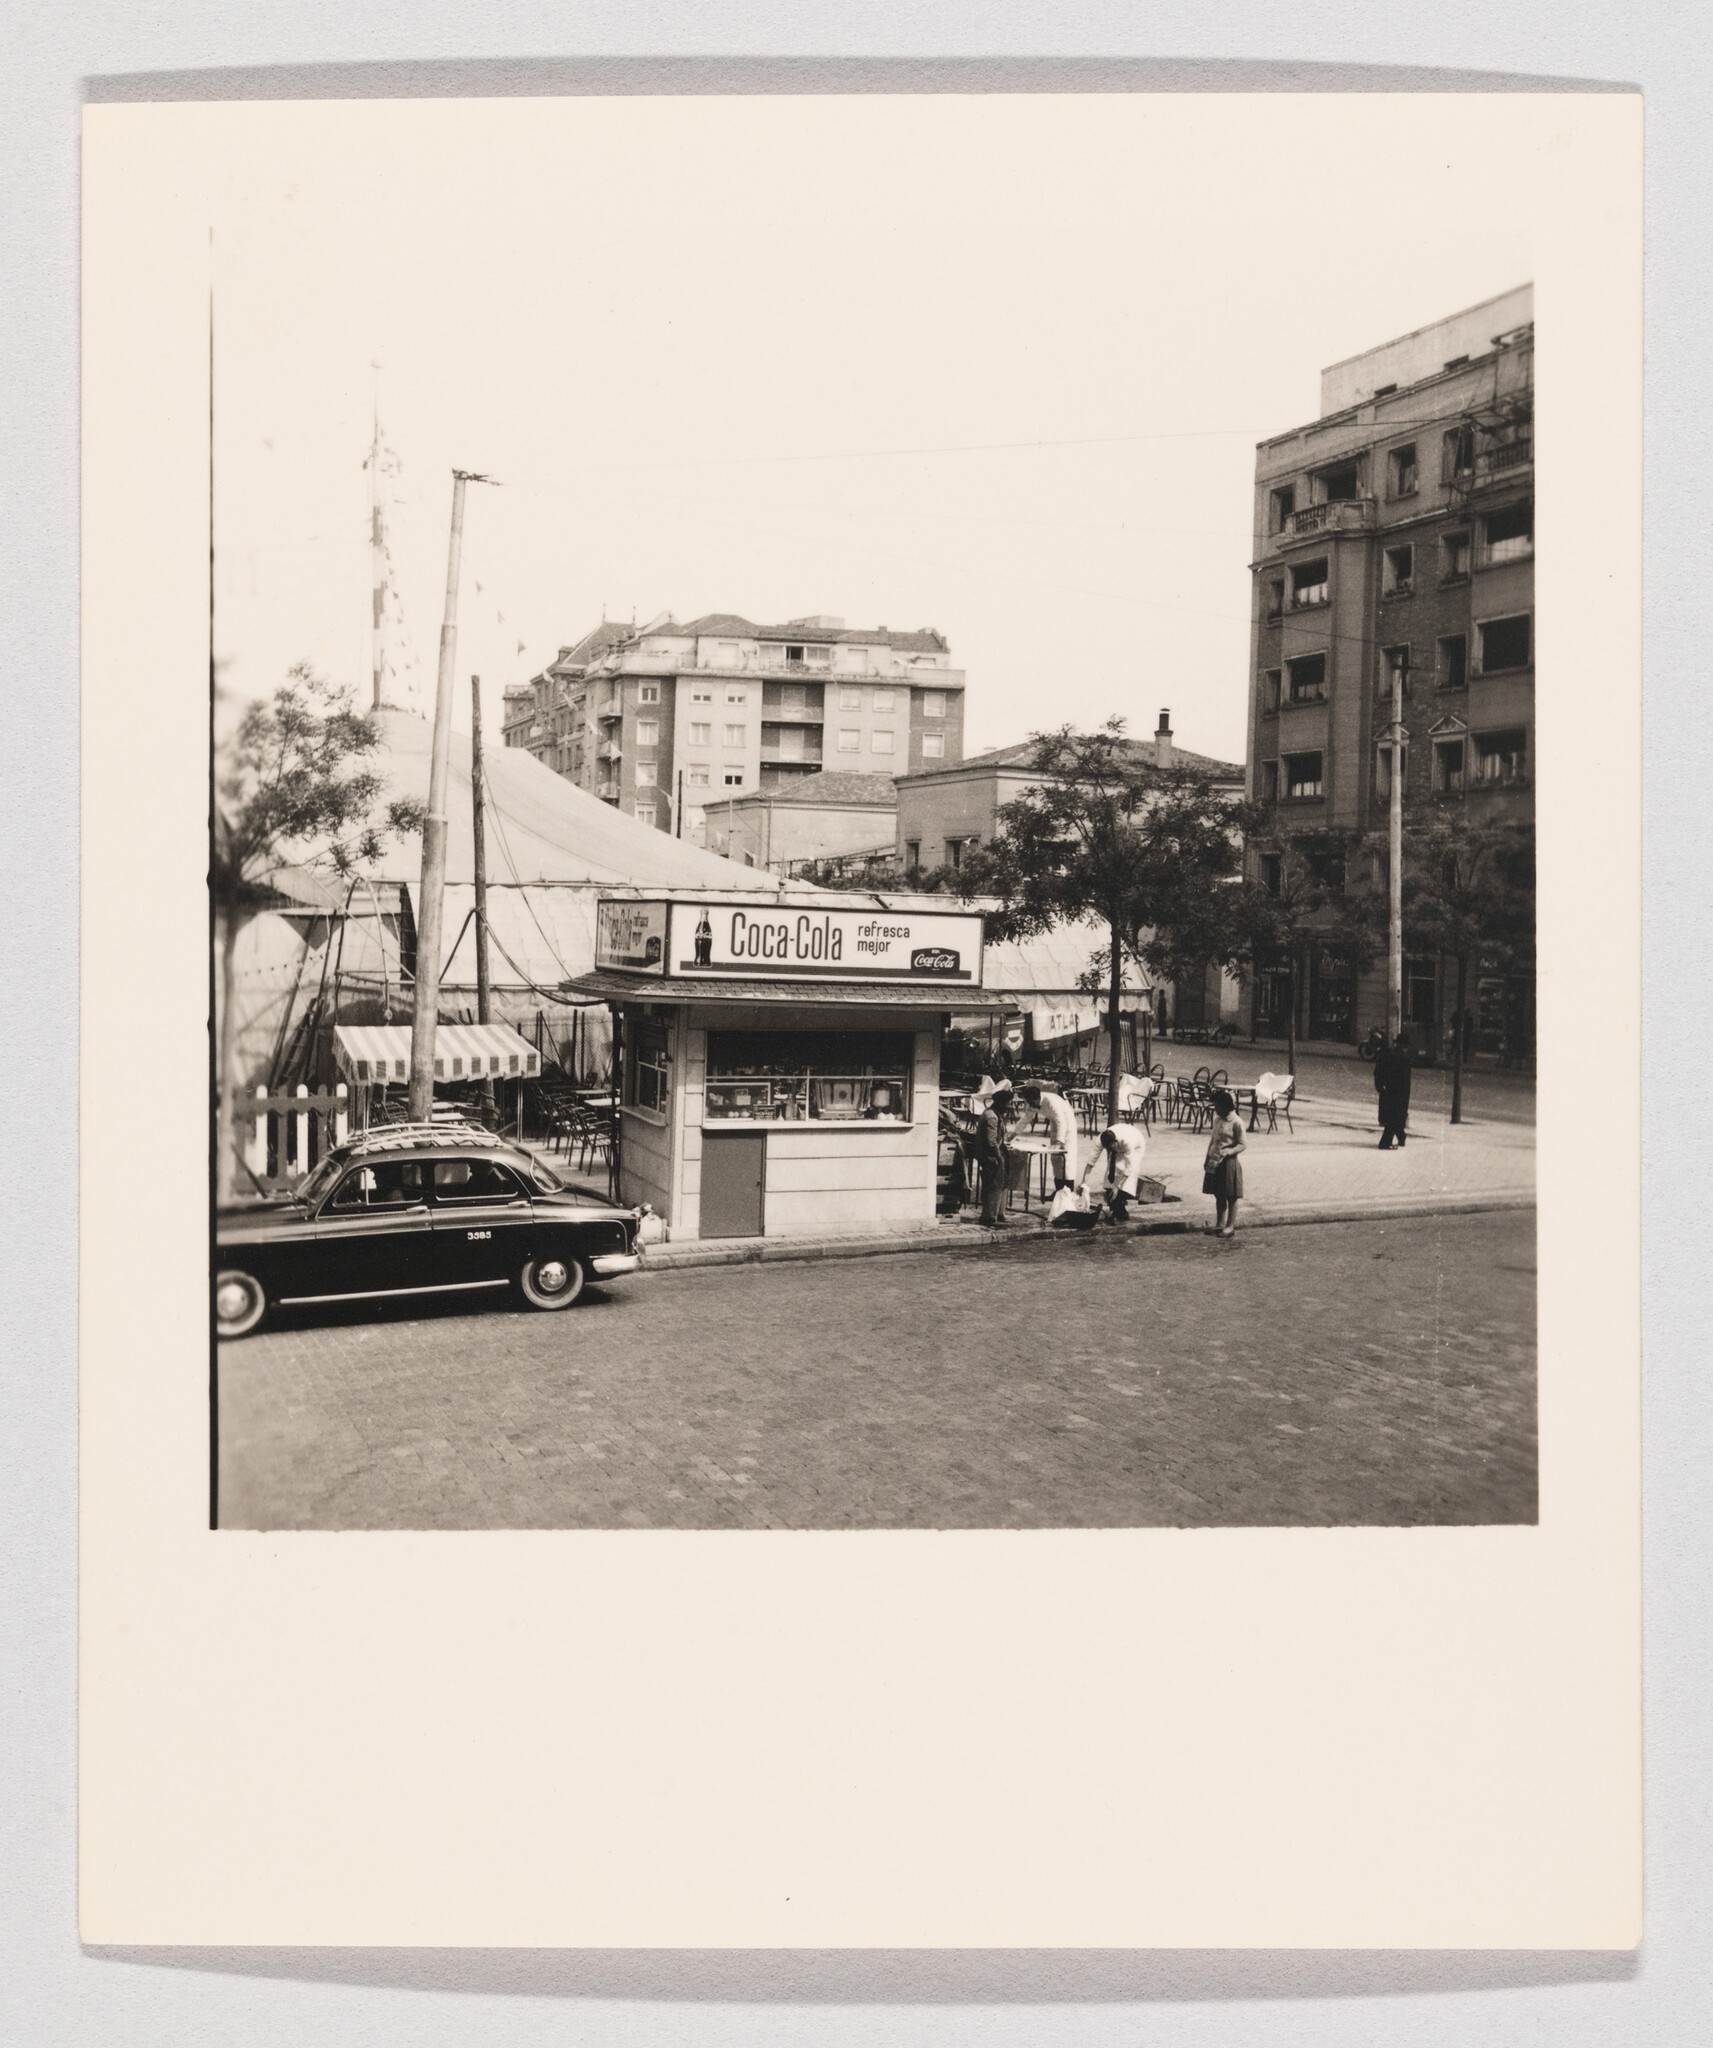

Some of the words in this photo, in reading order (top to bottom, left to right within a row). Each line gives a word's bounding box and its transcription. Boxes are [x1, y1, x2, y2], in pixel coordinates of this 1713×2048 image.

[730, 911, 842, 961] Coca-Cola
[857, 920, 910, 938] refresca
[857, 938, 891, 956] mejor
[913, 953, 956, 968] Coca-Cola
